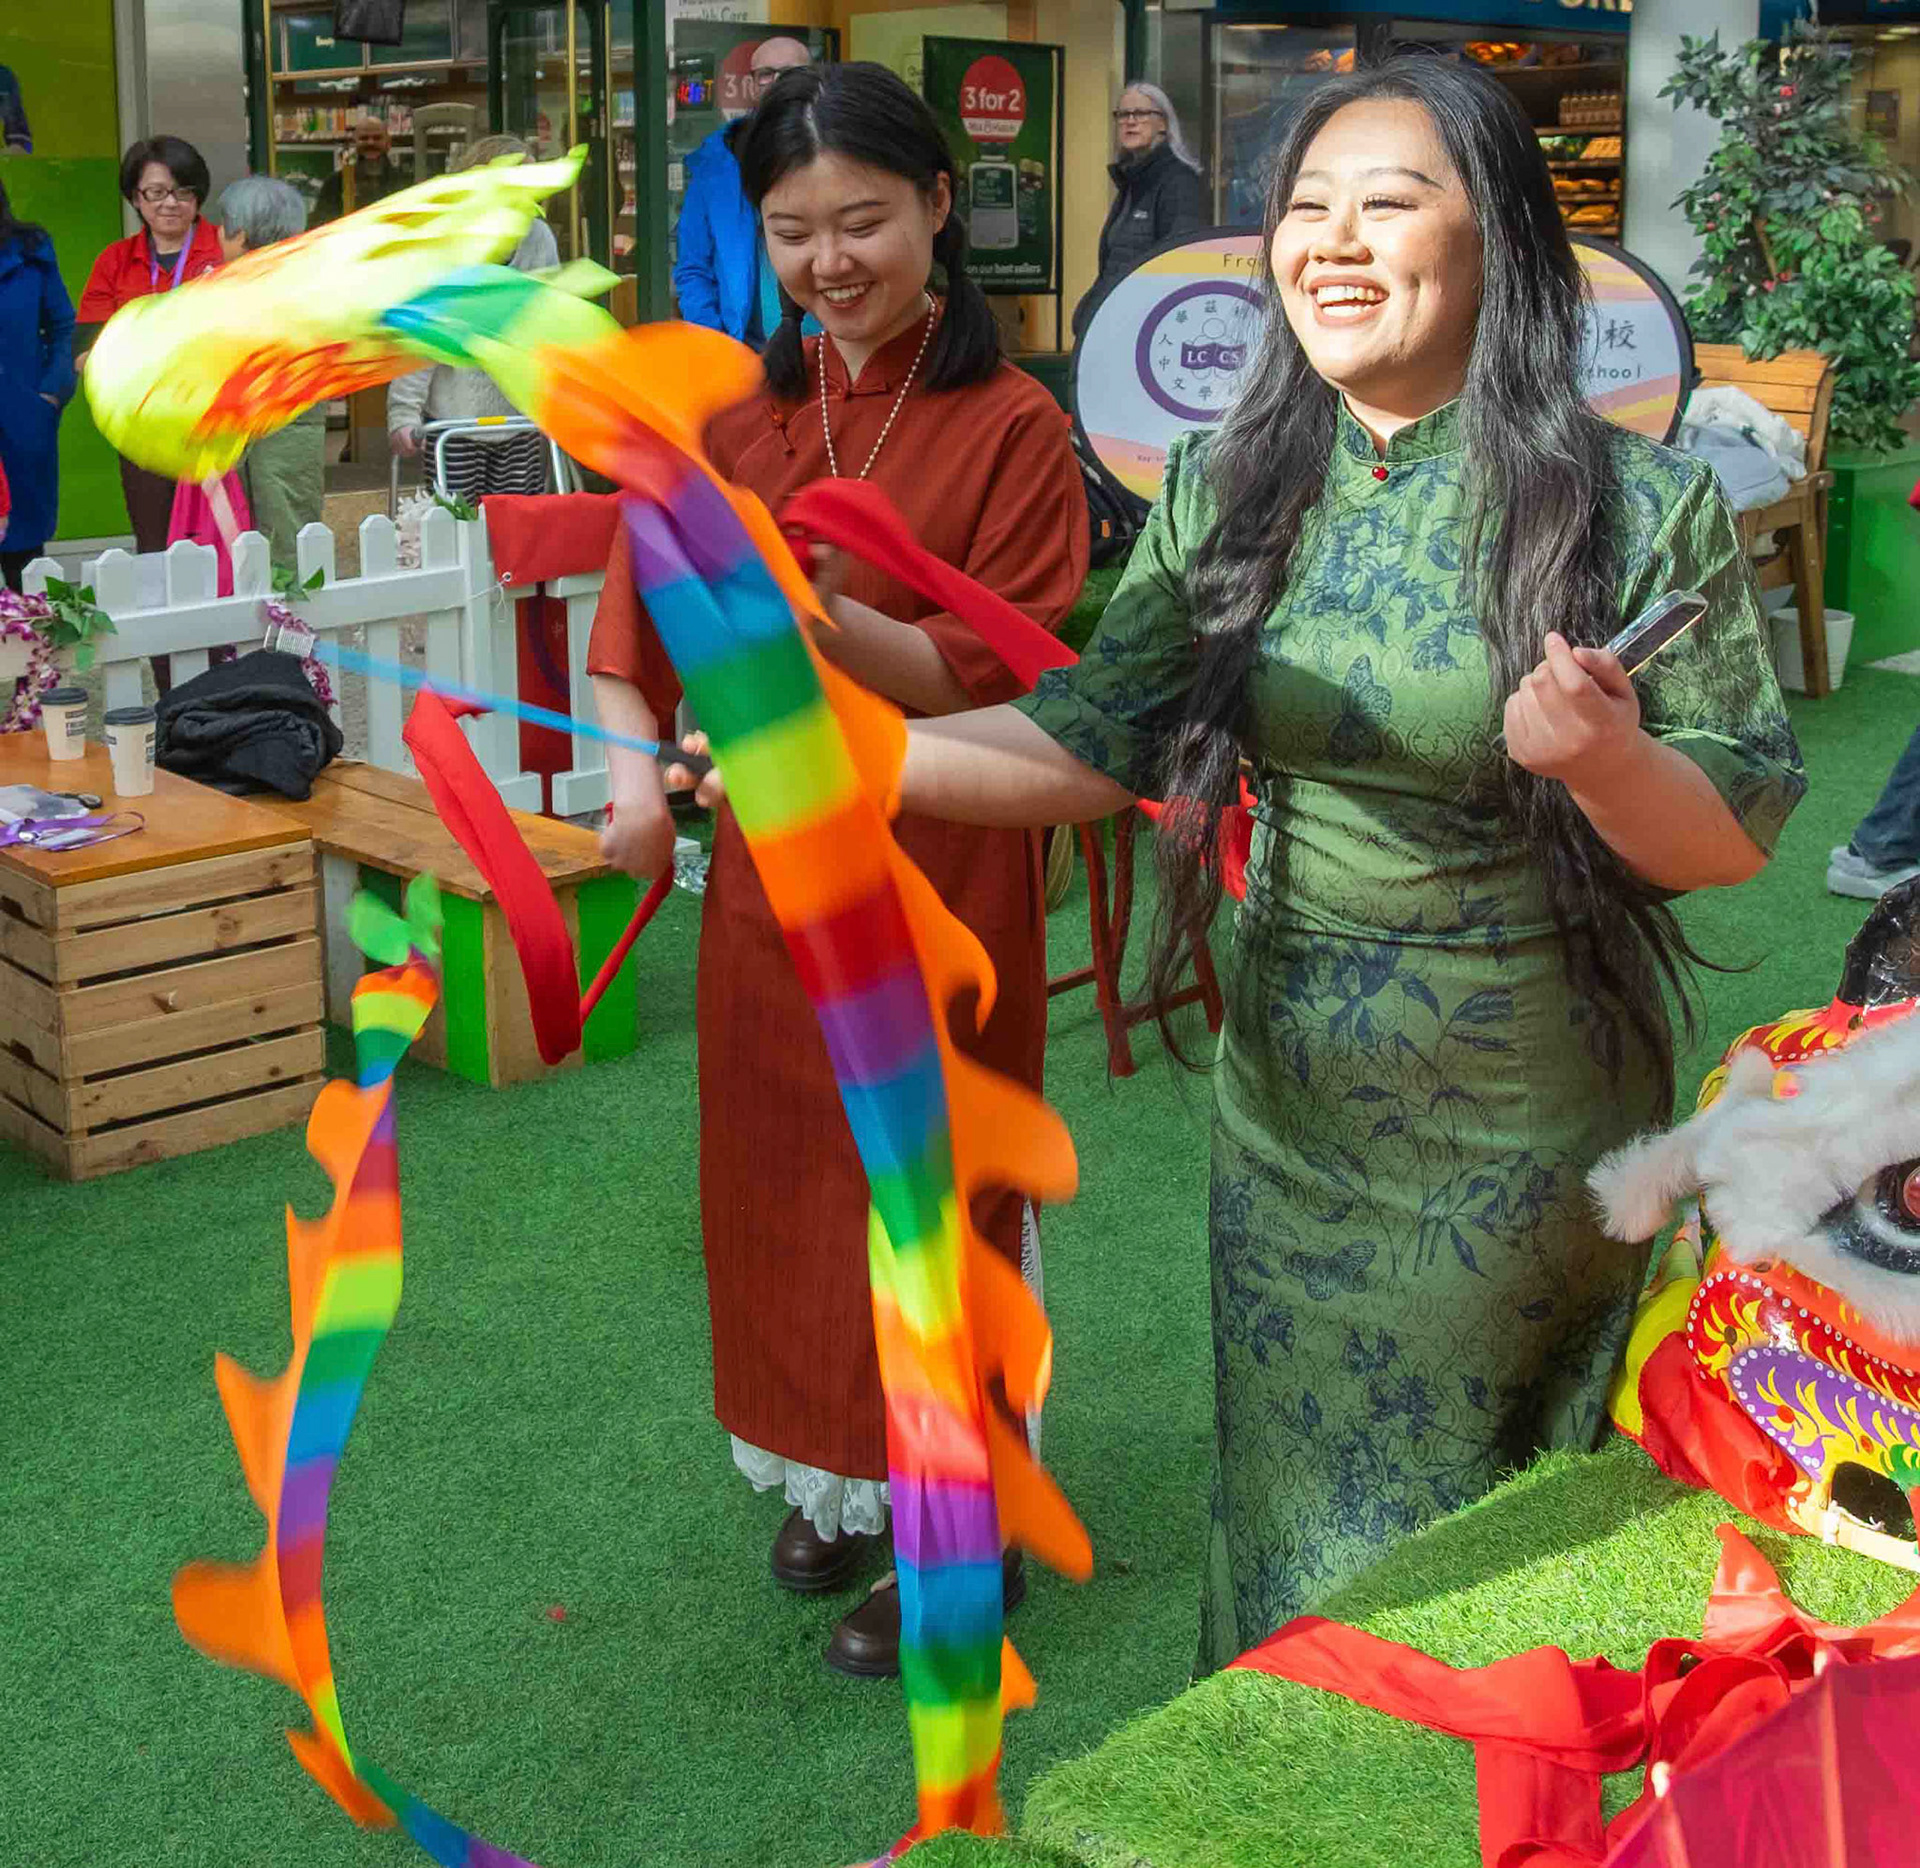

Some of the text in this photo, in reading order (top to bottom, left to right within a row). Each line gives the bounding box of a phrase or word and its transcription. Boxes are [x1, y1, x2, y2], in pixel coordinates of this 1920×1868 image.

[724, 73, 737, 98] 3
[965, 87, 1020, 111] 3 for 2
[1187, 351, 1208, 364] LC
